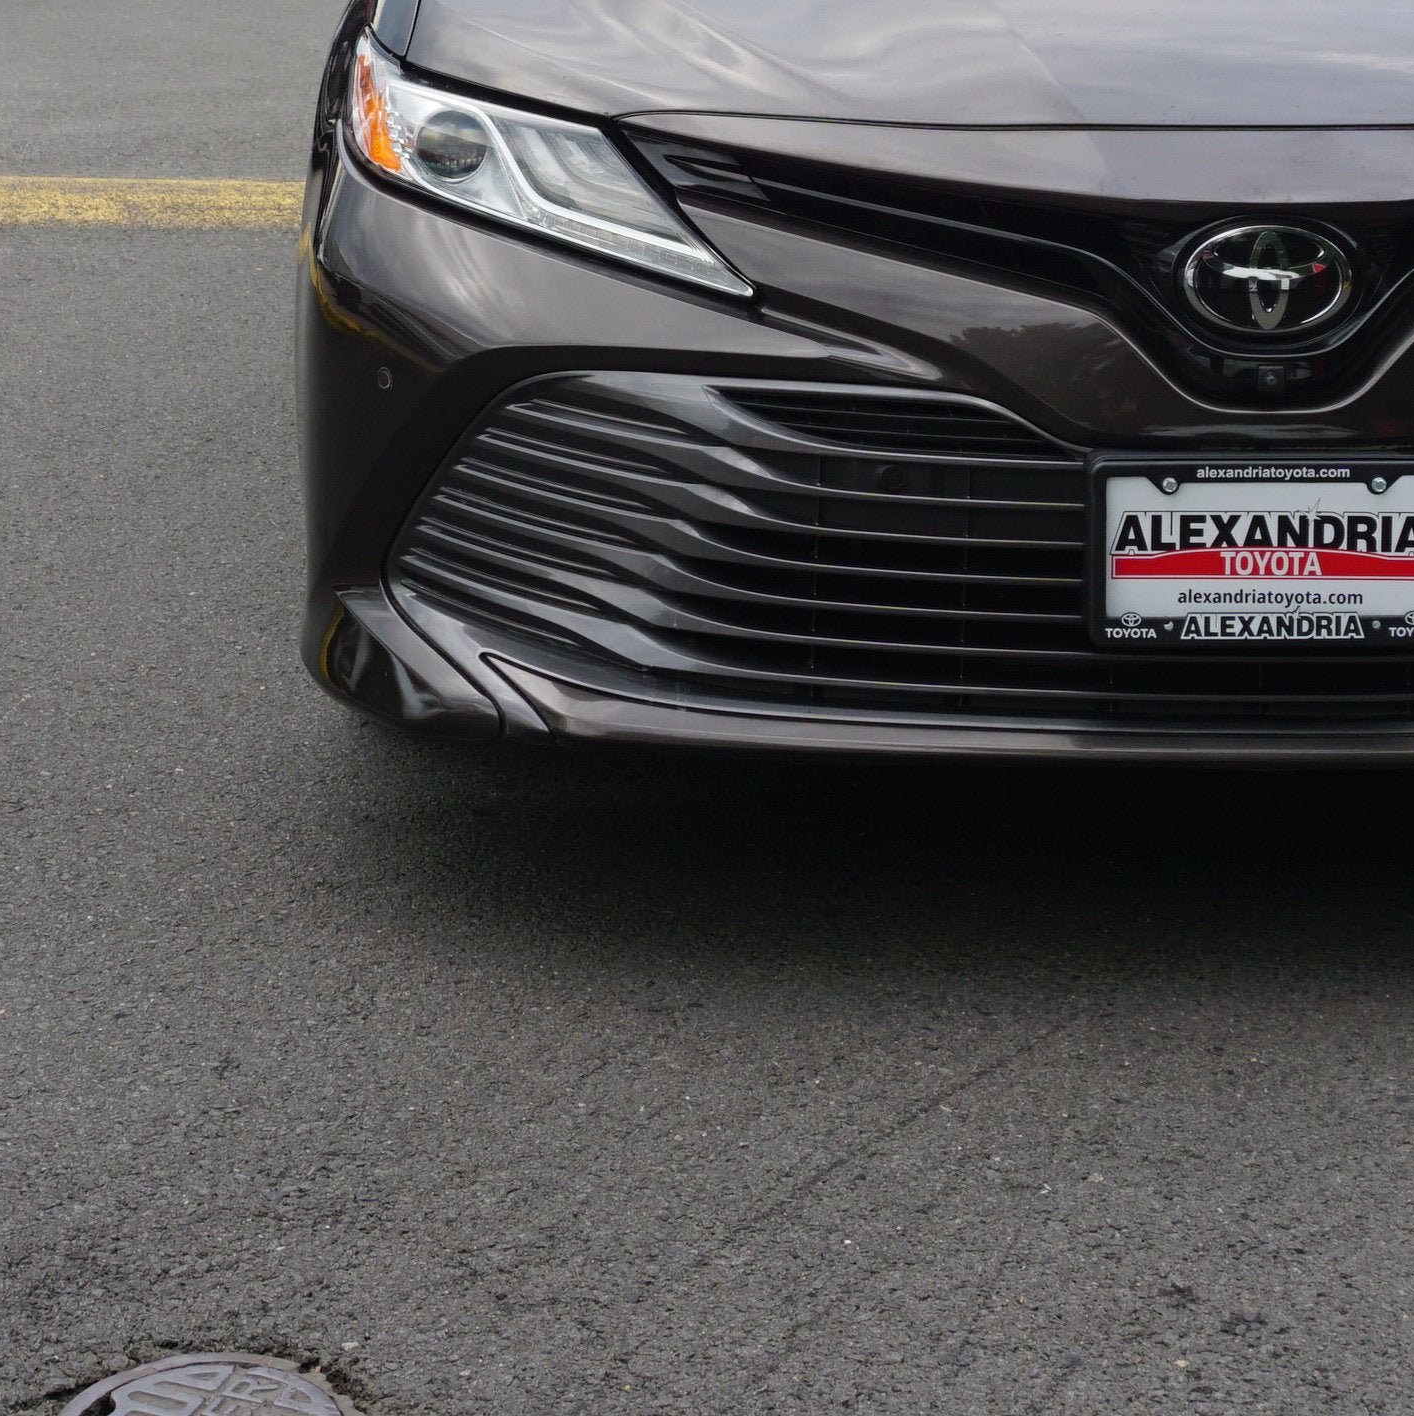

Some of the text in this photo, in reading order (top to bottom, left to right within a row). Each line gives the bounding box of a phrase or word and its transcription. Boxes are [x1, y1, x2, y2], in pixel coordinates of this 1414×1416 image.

[1197, 466, 1351, 480] alexandriatoyota.com
[1220, 551, 1323, 576] TOYOTA
[1178, 589, 1364, 607] alexandriatoyota.com
[1105, 628, 1157, 639] TOYOTA
[1181, 612, 1365, 641] ALEXANDRIA
